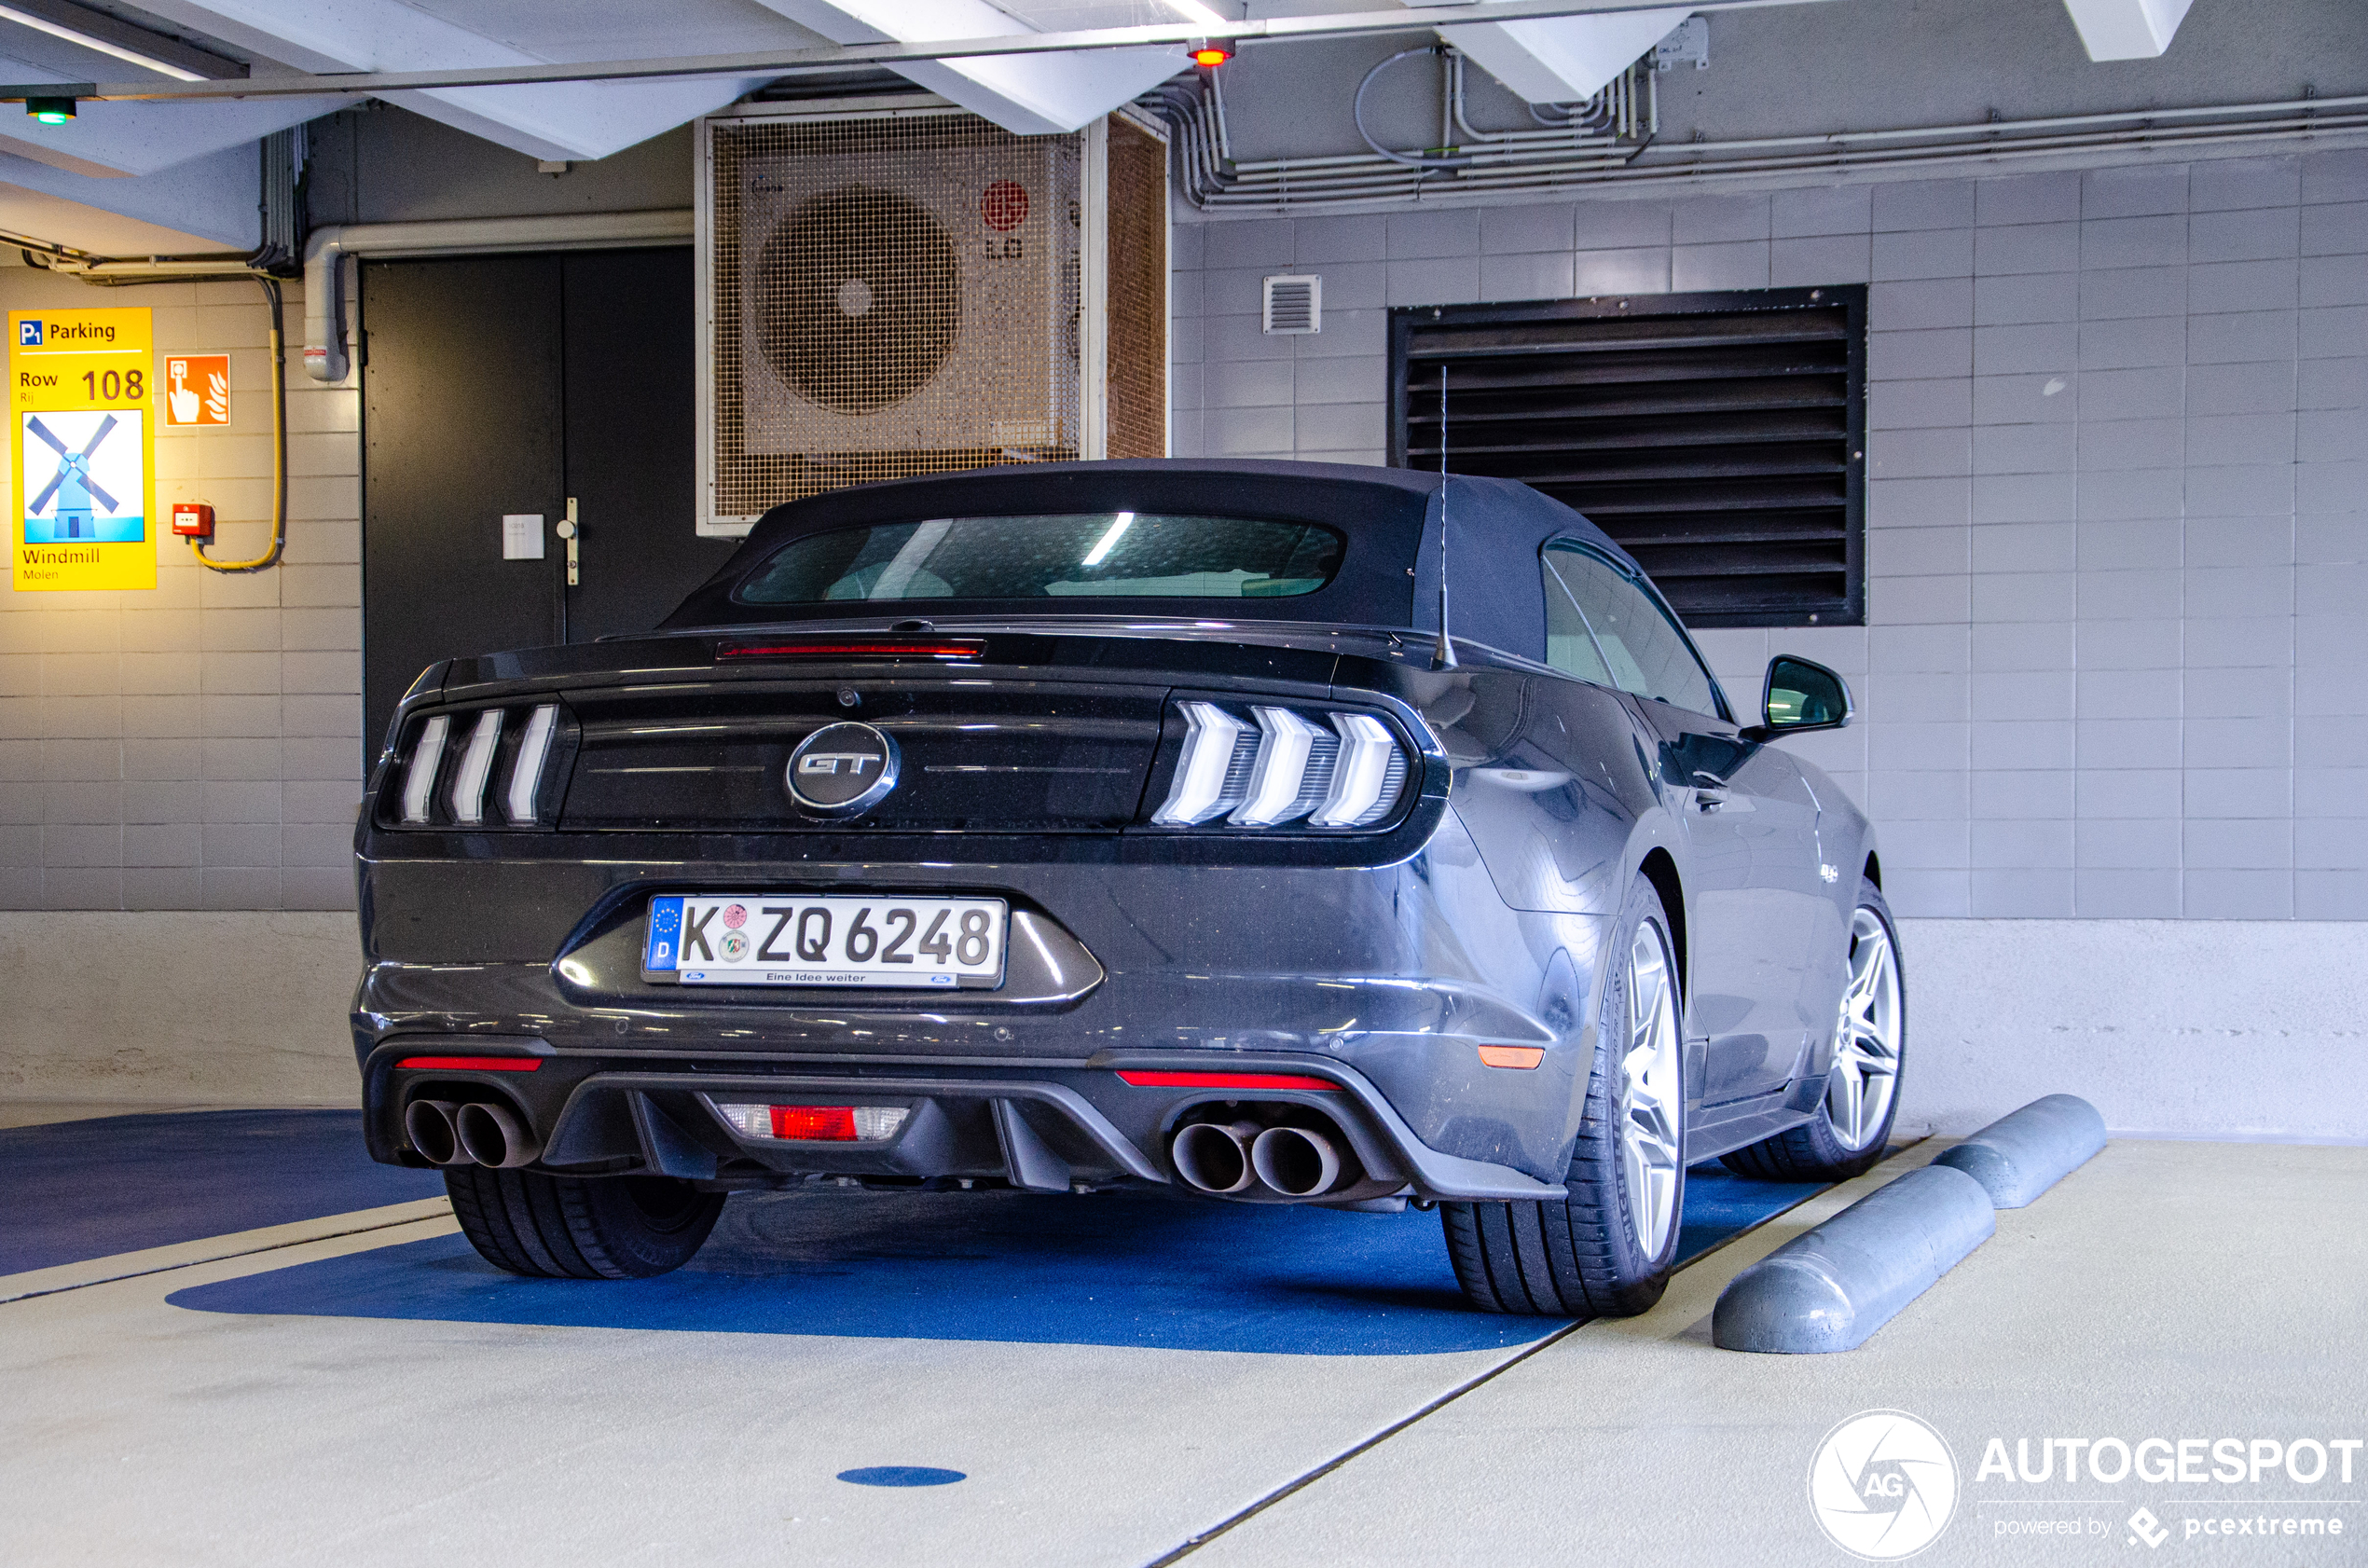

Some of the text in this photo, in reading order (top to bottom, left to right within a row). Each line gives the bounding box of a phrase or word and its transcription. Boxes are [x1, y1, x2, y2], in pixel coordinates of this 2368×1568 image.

[986, 239, 1023, 259] LG
[50, 323, 116, 342] Parking
[20, 369, 144, 401] Row 108
[21, 392, 34, 404] Rij
[23, 548, 100, 564] Windmill
[23, 569, 59, 580] Molen
[798, 753, 881, 774] GT
[657, 906, 992, 966] D K ZQ 6248
[766, 972, 792, 982] Eine
[795, 973, 822, 982] Idee
[826, 973, 866, 983] weiter
[1612, 1107, 1634, 1244] MICHELIN
